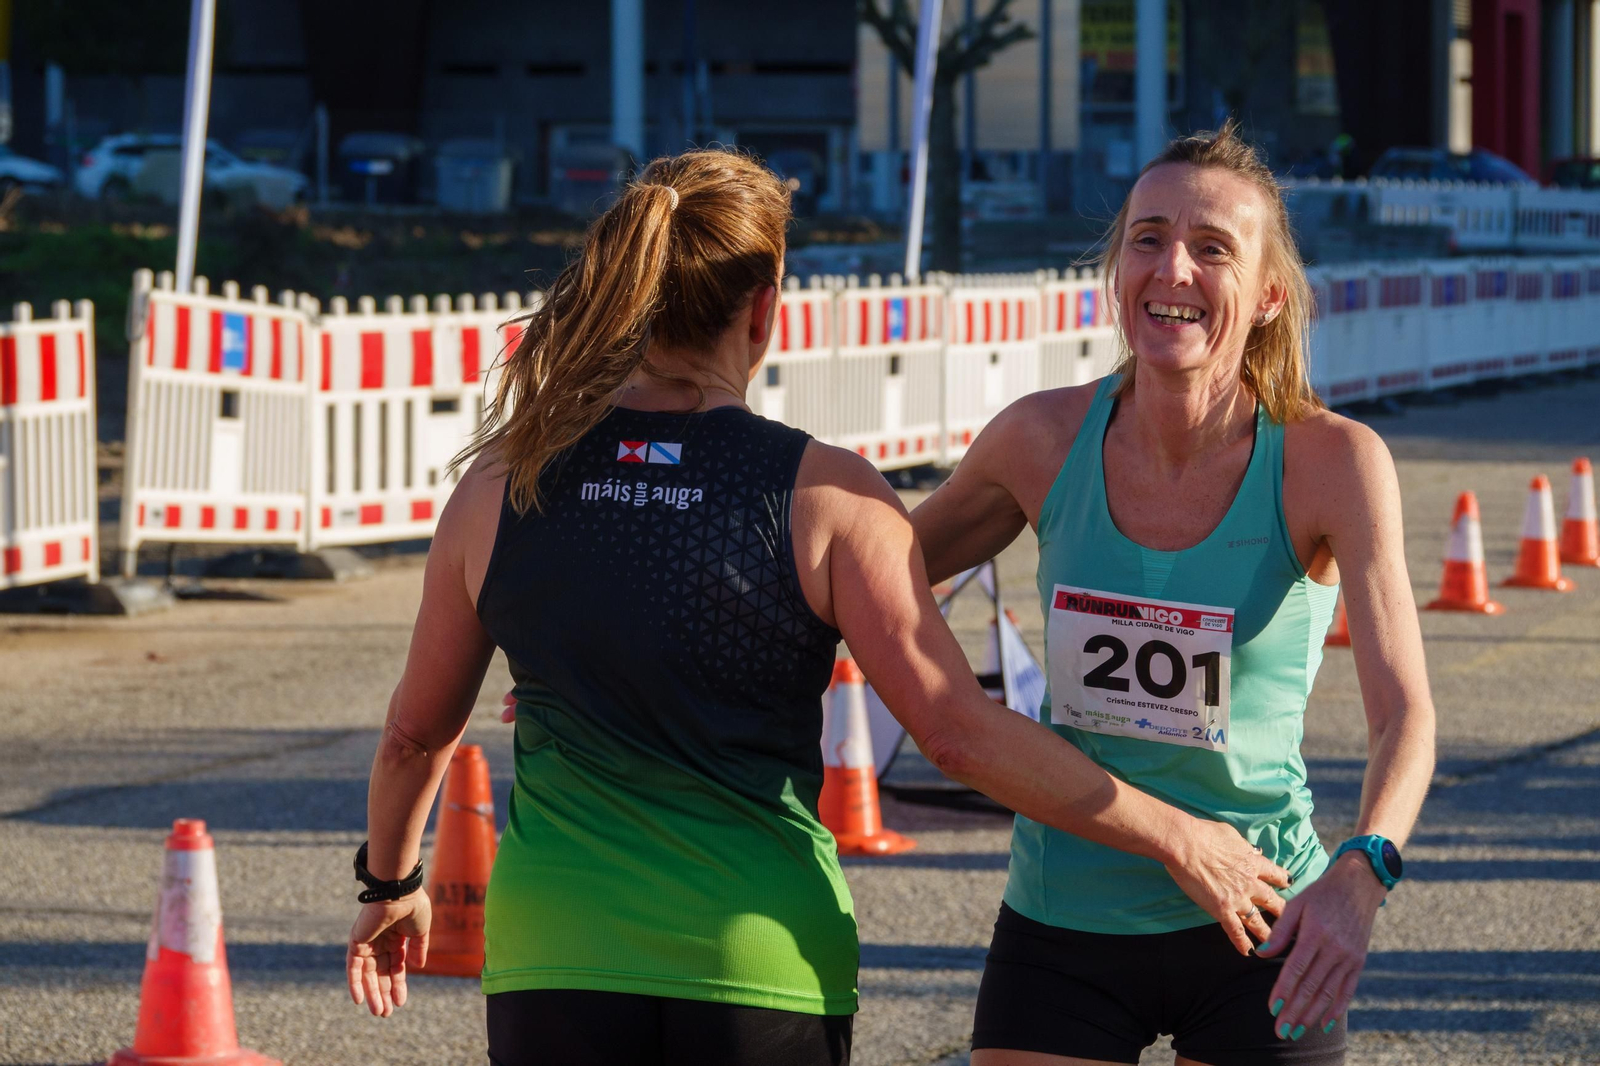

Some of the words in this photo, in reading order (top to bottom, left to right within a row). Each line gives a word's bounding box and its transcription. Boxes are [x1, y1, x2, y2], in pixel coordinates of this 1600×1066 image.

[581, 478, 632, 502] máis
[652, 485, 703, 509] auga
[1236, 537, 1269, 547] SIMOND
[1112, 619, 1133, 627] MILLA
[1136, 621, 1163, 630] CIDADE
[1165, 624, 1174, 632] DE
[1176, 627, 1194, 636] VIGO
[1083, 634, 1221, 706] 201
[1106, 697, 1136, 706] Cristina
[1138, 701, 1168, 711] ESTEVEZ
[1170, 706, 1198, 717] CRESPO
